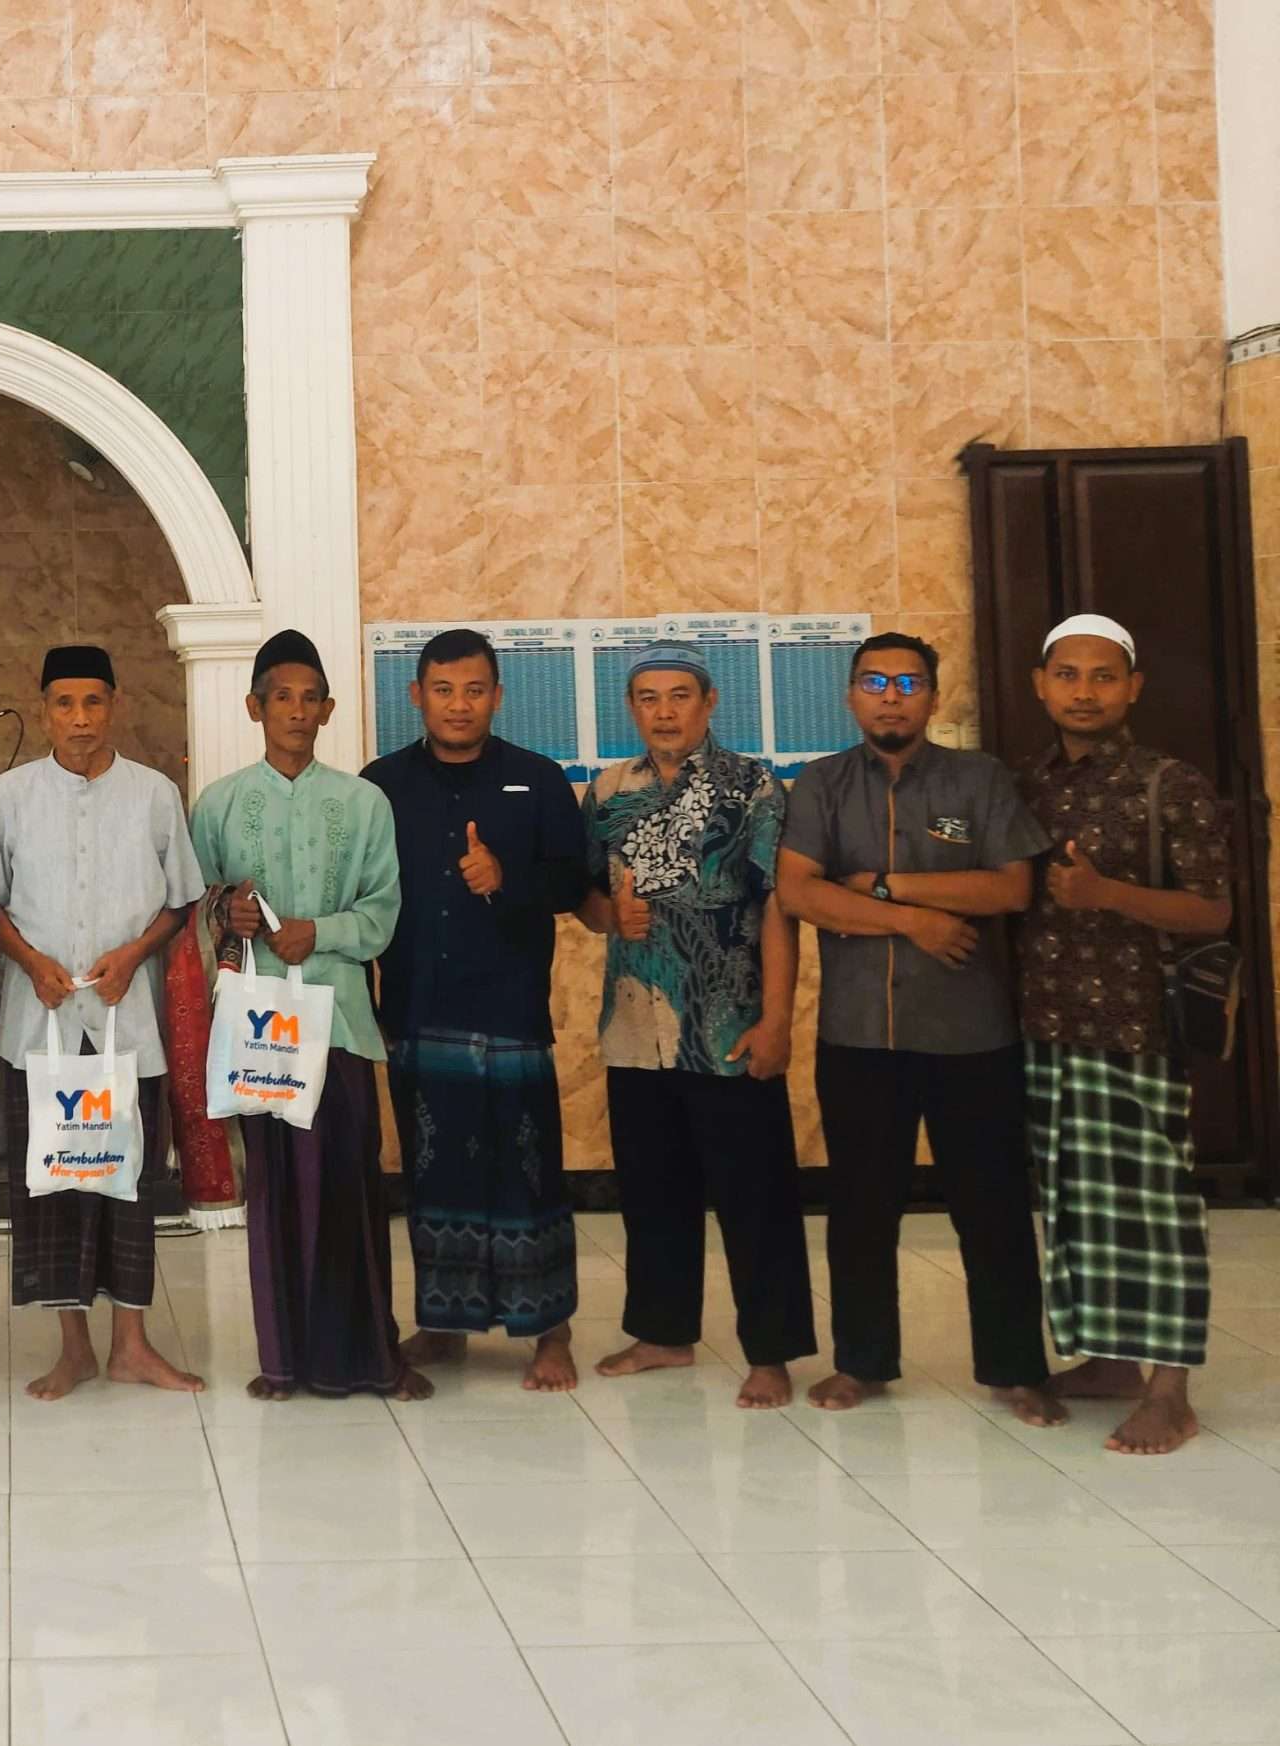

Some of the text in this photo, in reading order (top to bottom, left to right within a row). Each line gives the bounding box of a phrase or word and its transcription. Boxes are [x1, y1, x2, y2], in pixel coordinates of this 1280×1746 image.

[246, 1009, 299, 1045] YM
[244, 1040, 299, 1055] Yatim Mandiri
[55, 1088, 112, 1121] YM
[55, 1121, 113, 1131] Yatim Mandiri
